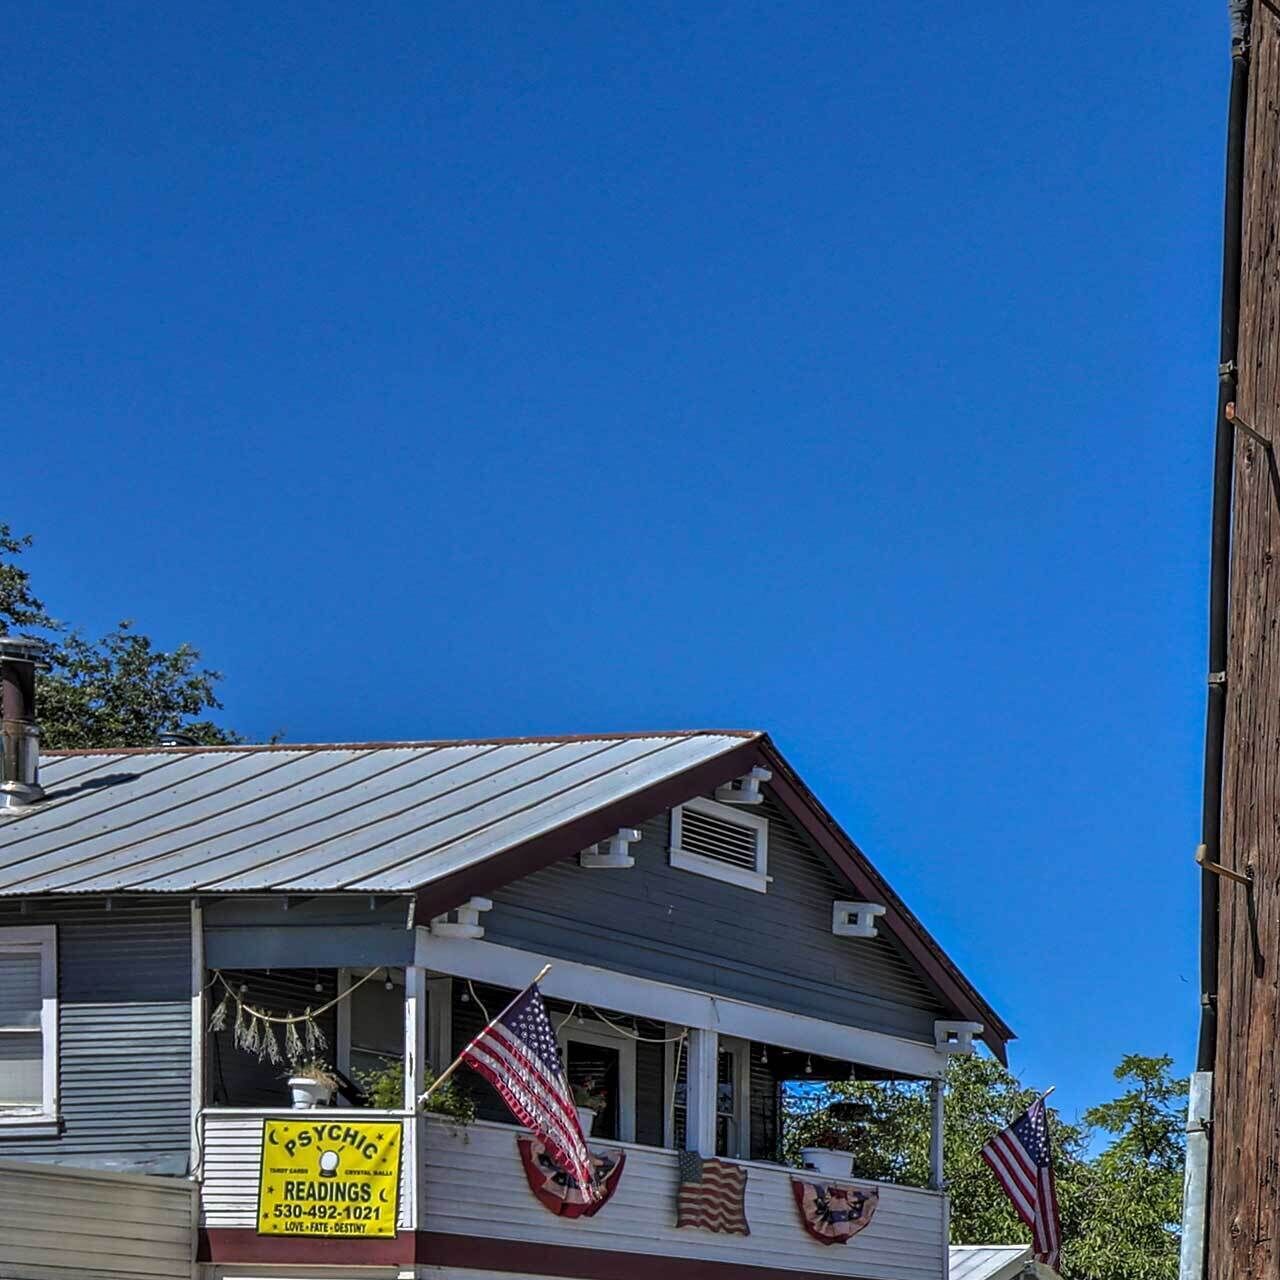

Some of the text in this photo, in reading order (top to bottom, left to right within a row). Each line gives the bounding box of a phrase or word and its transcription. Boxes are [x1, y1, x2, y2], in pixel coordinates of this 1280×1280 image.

[284, 1124, 378, 1160] PSYCHIC
[284, 1181, 372, 1203] READINGS
[273, 1203, 381, 1220] 530-492-1021
[285, 1221, 367, 1234] LOVE FATE DESTINY
